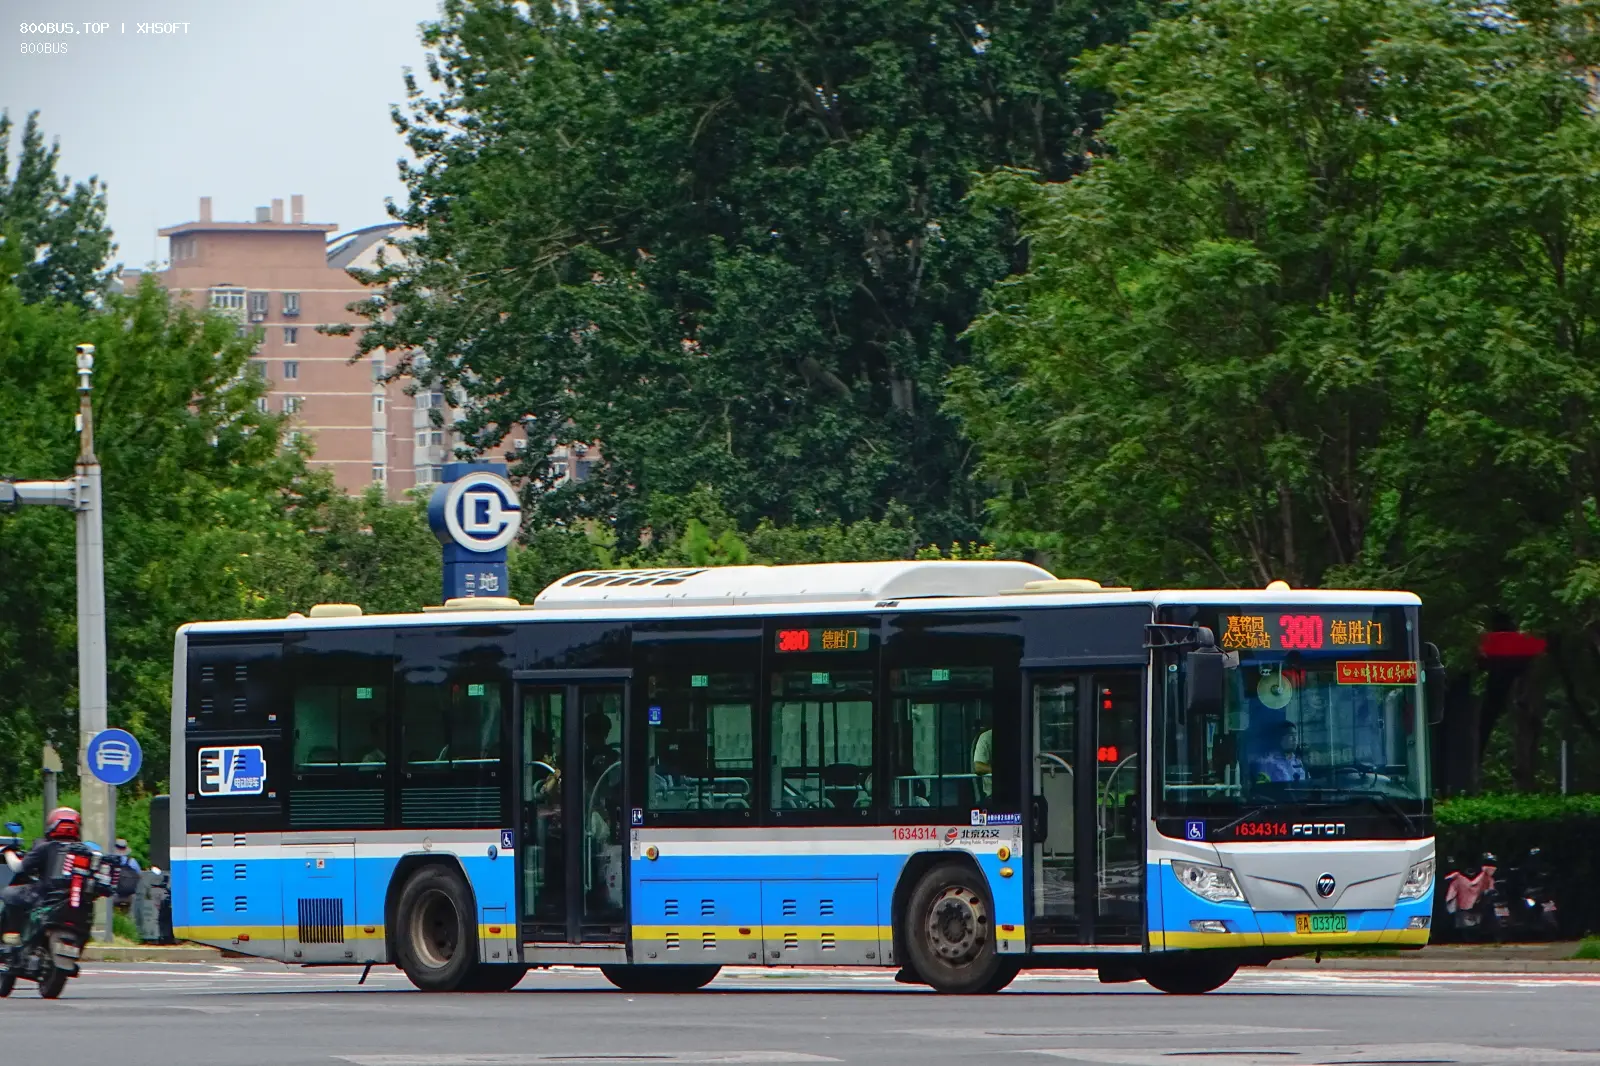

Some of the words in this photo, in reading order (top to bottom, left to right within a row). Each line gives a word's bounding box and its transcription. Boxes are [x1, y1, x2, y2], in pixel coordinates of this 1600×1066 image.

[479, 572, 499, 591] 地
[1227, 616, 1264, 632] 嘉铭园
[1279, 614, 1324, 648] 380
[822, 630, 857, 649] 德胜门
[1222, 632, 1271, 648] 公交场站
[1330, 620, 1383, 645] 德胜门
[892, 827, 937, 841] 1634314
[961, 829, 1000, 840] 北京公交
[1236, 822, 1287, 836] 1634314
[1292, 823, 1346, 836] FOTON
